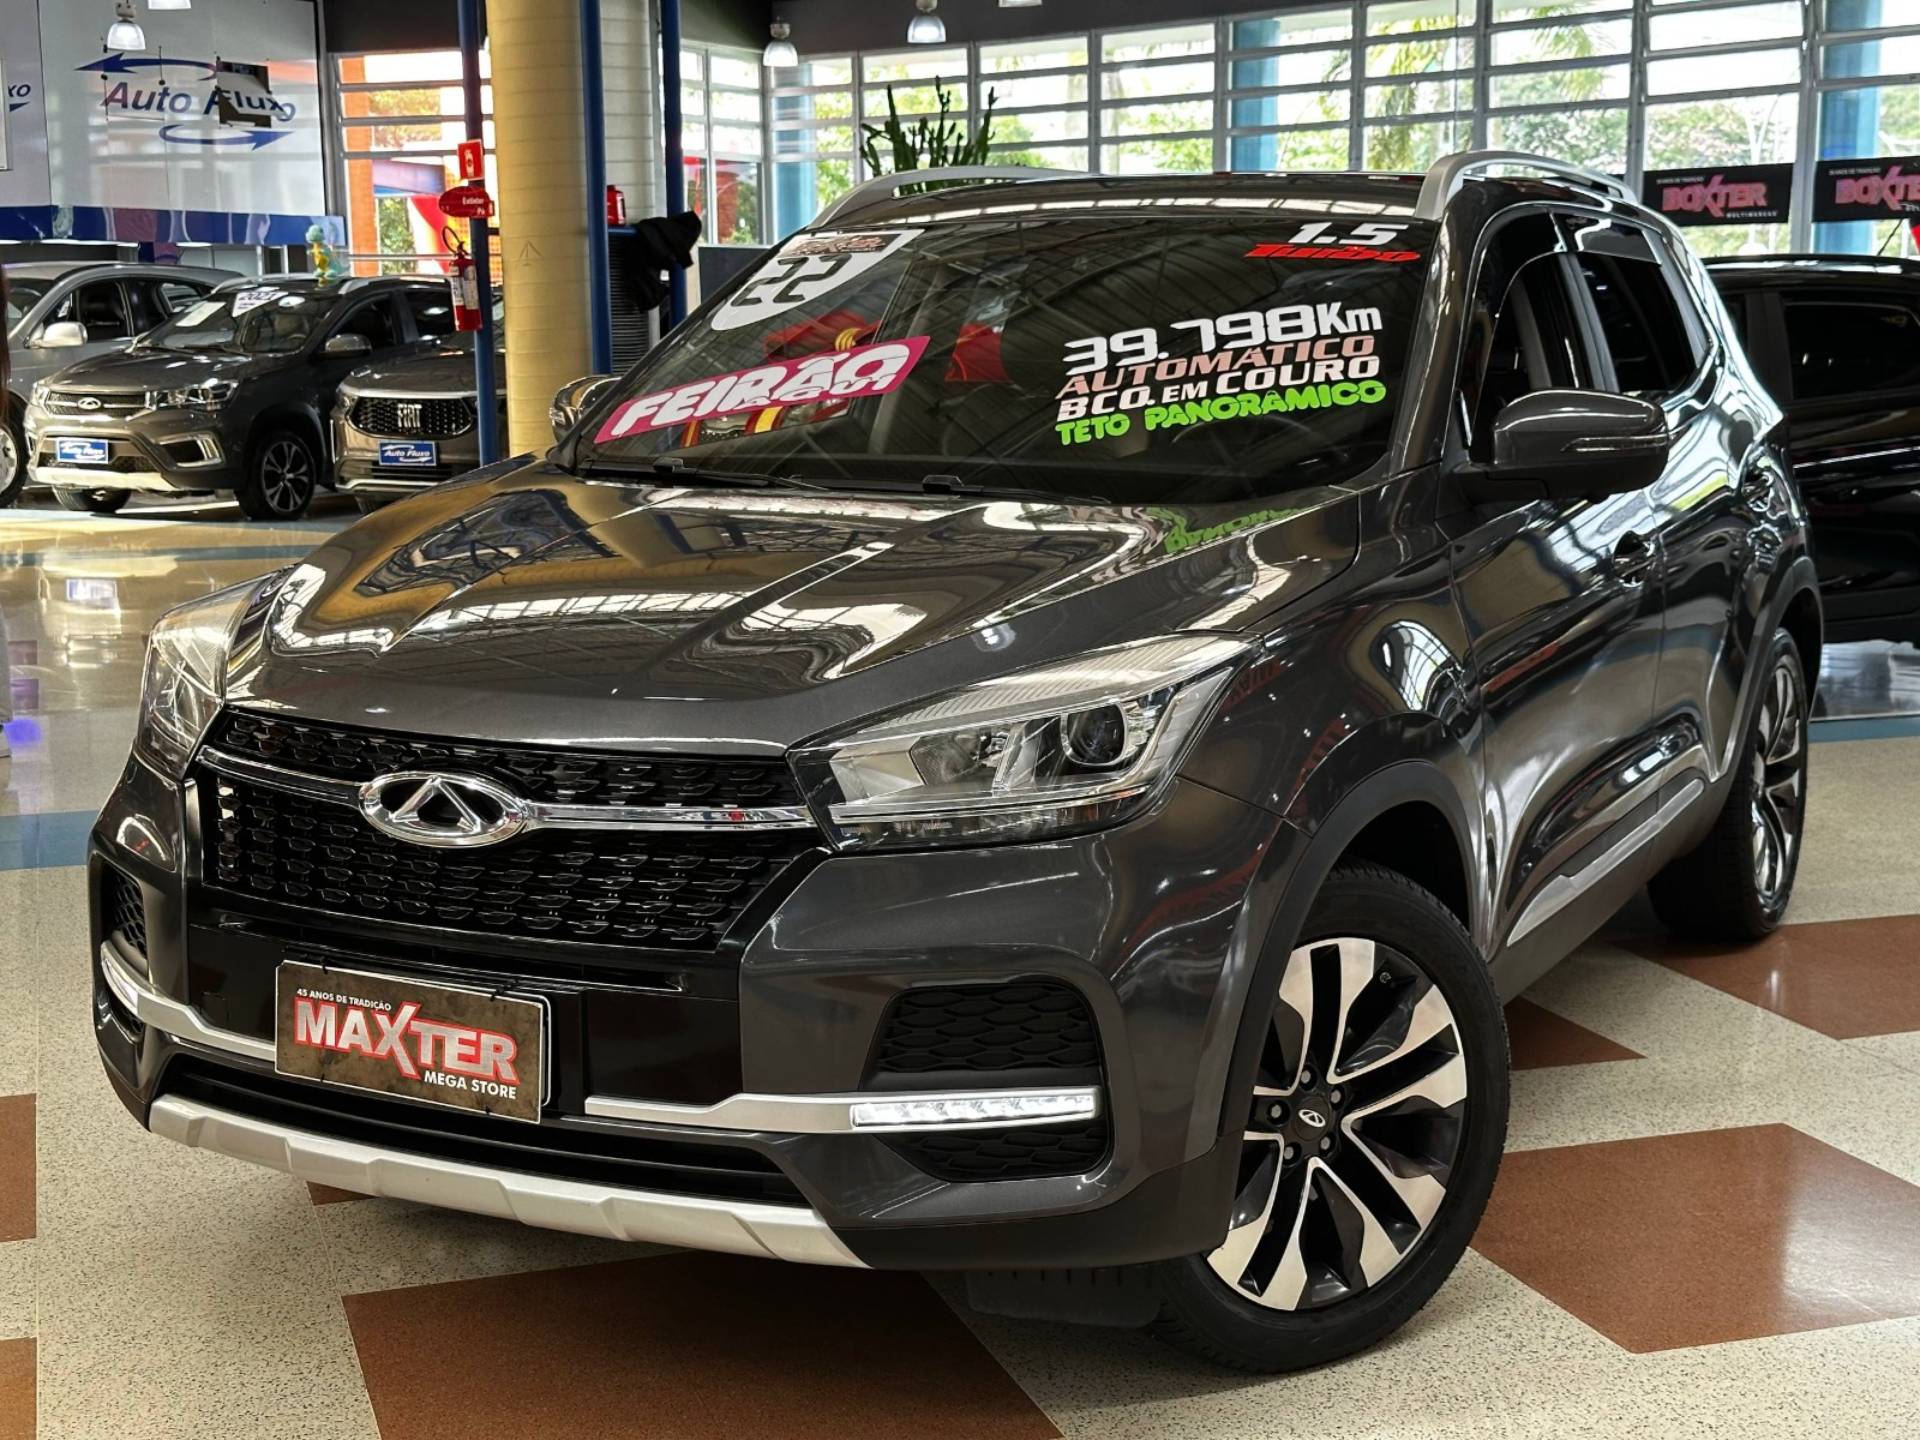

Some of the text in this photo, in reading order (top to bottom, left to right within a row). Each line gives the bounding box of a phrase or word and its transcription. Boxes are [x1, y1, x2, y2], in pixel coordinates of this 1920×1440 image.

[101, 81, 296, 122] Auto Fluxo
[1662, 174, 1767, 217] BOXTER
[1244, 243, 1421, 262] Turbo
[1288, 221, 1409, 246] 1.5
[730, 254, 852, 306] 22
[611, 344, 910, 436] FEIRÃO
[1056, 355, 1380, 422] BCO. EM COURO
[397, 403, 423, 428] FIAT
[1055, 379, 1387, 446] TETO PANORÂMICO
[406, 450, 431, 458] Fluxo
[297, 988, 392, 1011] 45 ANOS DE TRADIÇÃO
[294, 996, 521, 1086] MAXTER
[424, 1070, 517, 1099] MEGA STORE
